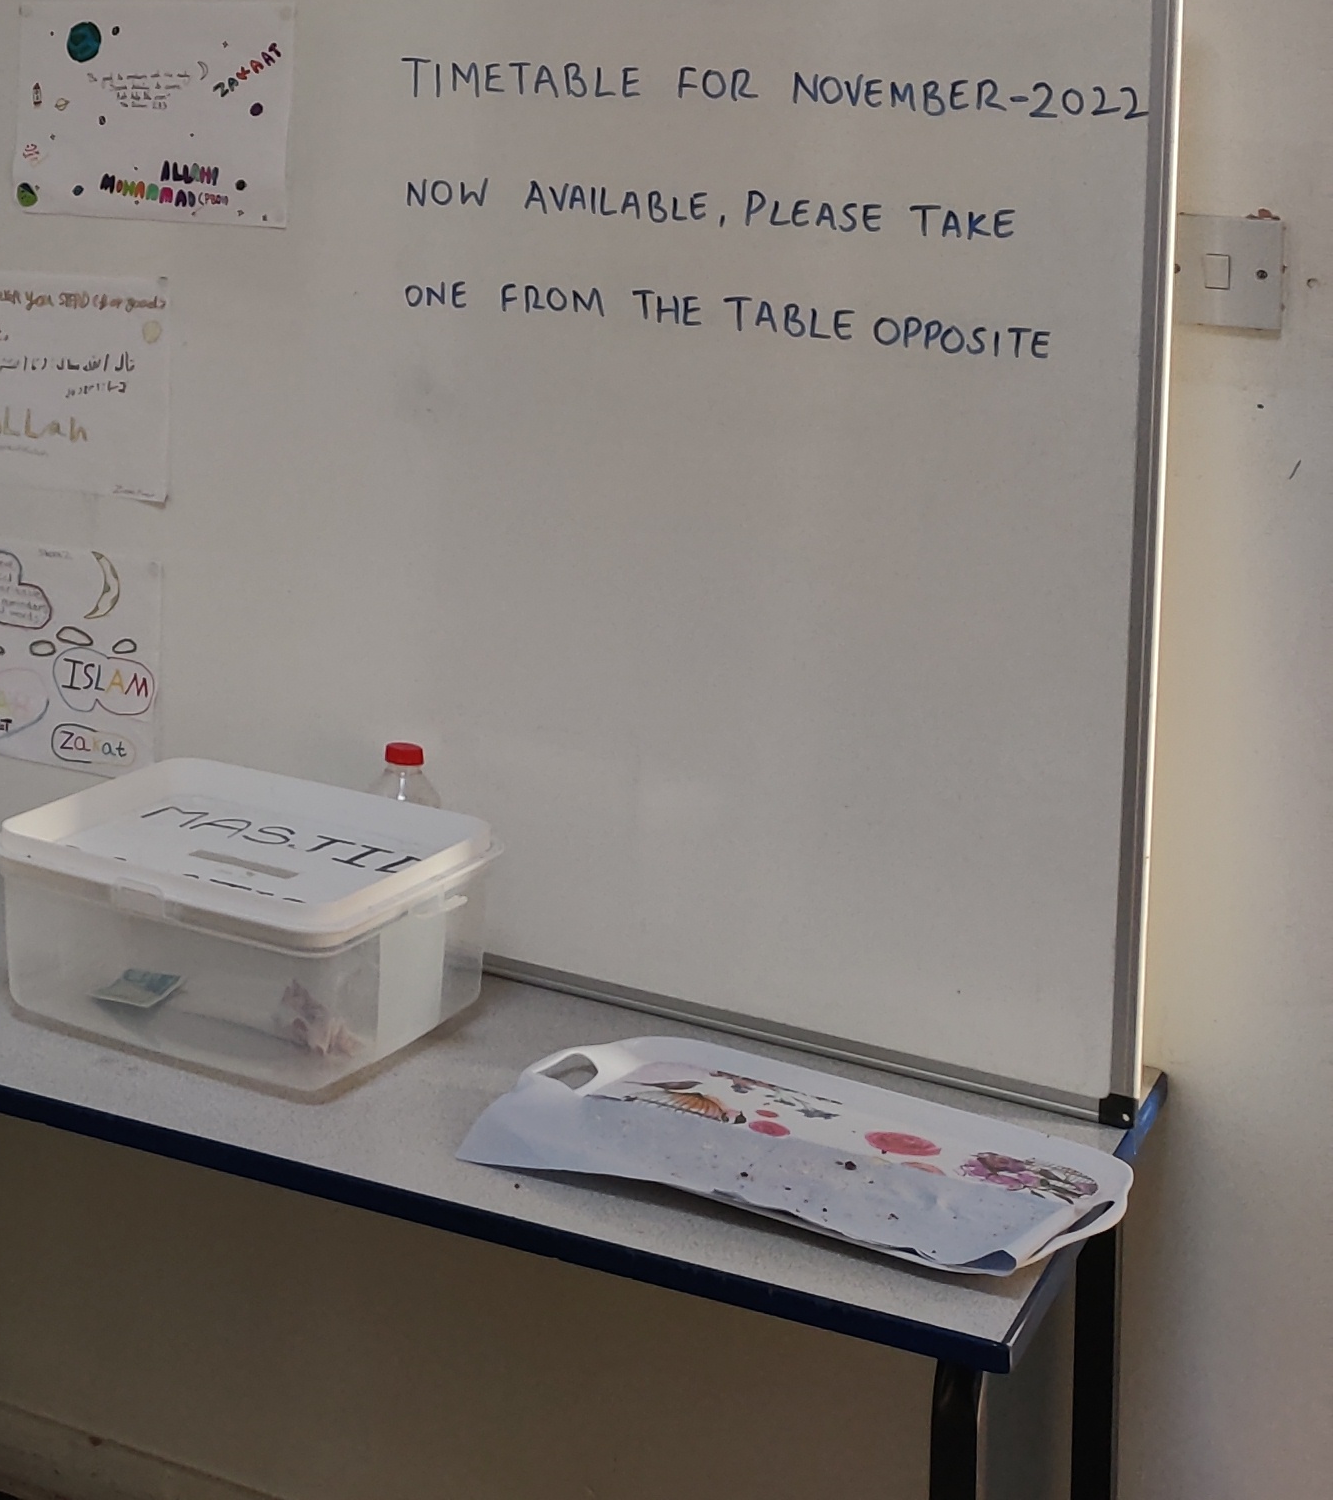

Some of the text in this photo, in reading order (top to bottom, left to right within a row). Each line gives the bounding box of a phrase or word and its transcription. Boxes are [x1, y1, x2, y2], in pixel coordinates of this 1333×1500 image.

[212, 42, 282, 98] ZAKAAT
[401, 56, 642, 99] TIMETABLE
[678, 66, 759, 101] FOR
[406, 177, 489, 207] NOW
[743, 189, 883, 233] PLEASE
[909, 204, 1017, 241] TAKE
[404, 280, 1052, 360] ONE FROM THE TABLE OPPOSITE
[61, 657, 149, 698] ISLAM
[59, 729, 128, 758] Zakat
